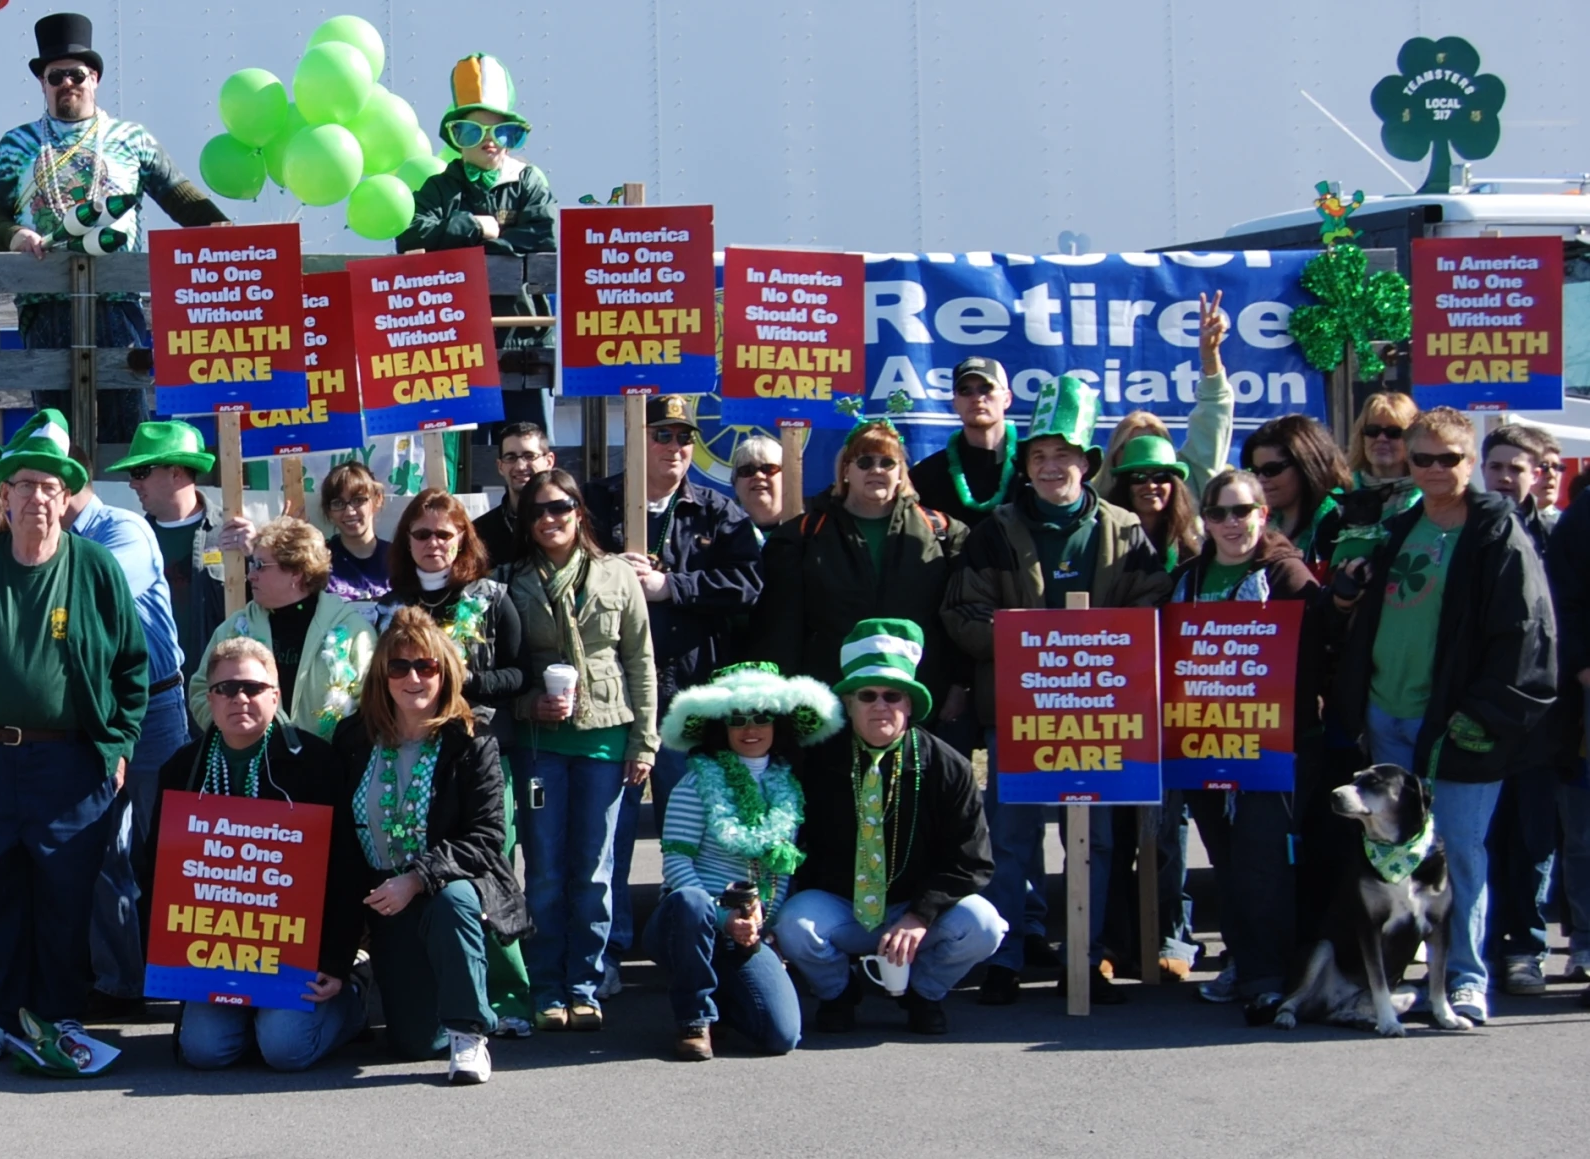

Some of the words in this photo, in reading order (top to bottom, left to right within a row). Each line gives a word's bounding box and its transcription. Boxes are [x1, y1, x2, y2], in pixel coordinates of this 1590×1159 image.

[1402, 69, 1476, 96] TEAMSTERS
[1425, 98, 1461, 109] LOCAL
[1433, 110, 1452, 121] 317
[585, 229, 604, 244] In
[609, 227, 689, 243] America
[174, 249, 193, 264] In
[198, 246, 277, 264] America
[602, 249, 629, 264] No
[635, 248, 673, 263] One
[1437, 257, 1455, 271] In
[1460, 256, 1538, 270] America
[191, 268, 218, 283] No
[224, 266, 262, 282] One
[371, 278, 389, 292] In
[393, 270, 465, 290] America
[585, 268, 651, 284] Should
[657, 268, 685, 282] Go
[746, 268, 764, 282] In
[769, 269, 842, 286] America
[1452, 275, 1479, 289] No
[1485, 274, 1522, 289] One
[175, 288, 241, 304] Should
[246, 286, 274, 300] Go
[388, 295, 413, 310] No
[418, 291, 452, 306] One
[597, 289, 673, 304] Without
[761, 288, 788, 302] No
[792, 289, 828, 304] One
[1436, 294, 1501, 309] Should
[1506, 293, 1533, 307] Go
[187, 307, 263, 323] Without
[375, 310, 435, 330] Should
[440, 308, 465, 322] Go
[576, 308, 701, 336] HEALTH
[745, 306, 807, 322] Should
[812, 309, 838, 324] Go
[864, 280, 1295, 349] Retiree
[1447, 313, 1522, 327] Without
[168, 325, 291, 355] HEALTH
[304, 332, 328, 346] Go
[387, 327, 457, 348] Without
[756, 325, 827, 343] Without
[596, 340, 681, 365] CARE
[1427, 332, 1548, 355] HEALTH
[371, 343, 484, 379] HEALTH
[736, 345, 851, 372] HEALTH
[189, 357, 272, 384] CARE
[1446, 360, 1529, 383] CARE
[393, 374, 470, 404] CARE
[754, 374, 832, 400] CARE
[249, 399, 328, 428] CARE
[1180, 622, 1198, 636] In
[1201, 620, 1277, 635] America
[1021, 632, 1041, 647] In
[1046, 630, 1131, 646] America
[1192, 641, 1218, 655] No
[1223, 640, 1259, 655] One
[1038, 652, 1068, 667] No
[1074, 651, 1114, 666] One
[1174, 660, 1236, 676] Should
[1241, 660, 1268, 676] Go
[1021, 672, 1091, 688] Should
[1097, 671, 1126, 687] Go
[1184, 681, 1255, 697] Without
[1034, 693, 1114, 709] Without
[1163, 703, 1280, 728] HEALTH
[1012, 714, 1143, 740] HEALTH
[1181, 733, 1260, 759] CARE
[1034, 745, 1123, 771] CARE
[188, 815, 208, 833] In
[213, 818, 303, 843] America
[203, 839, 234, 858] No
[240, 843, 283, 863] One
[182, 860, 256, 883] Should
[262, 869, 293, 887] Go
[194, 883, 278, 908] Without
[167, 904, 306, 944] HEALTH
[187, 940, 280, 975] CARE
[215, 996, 243, 1004] AFL-CIO
